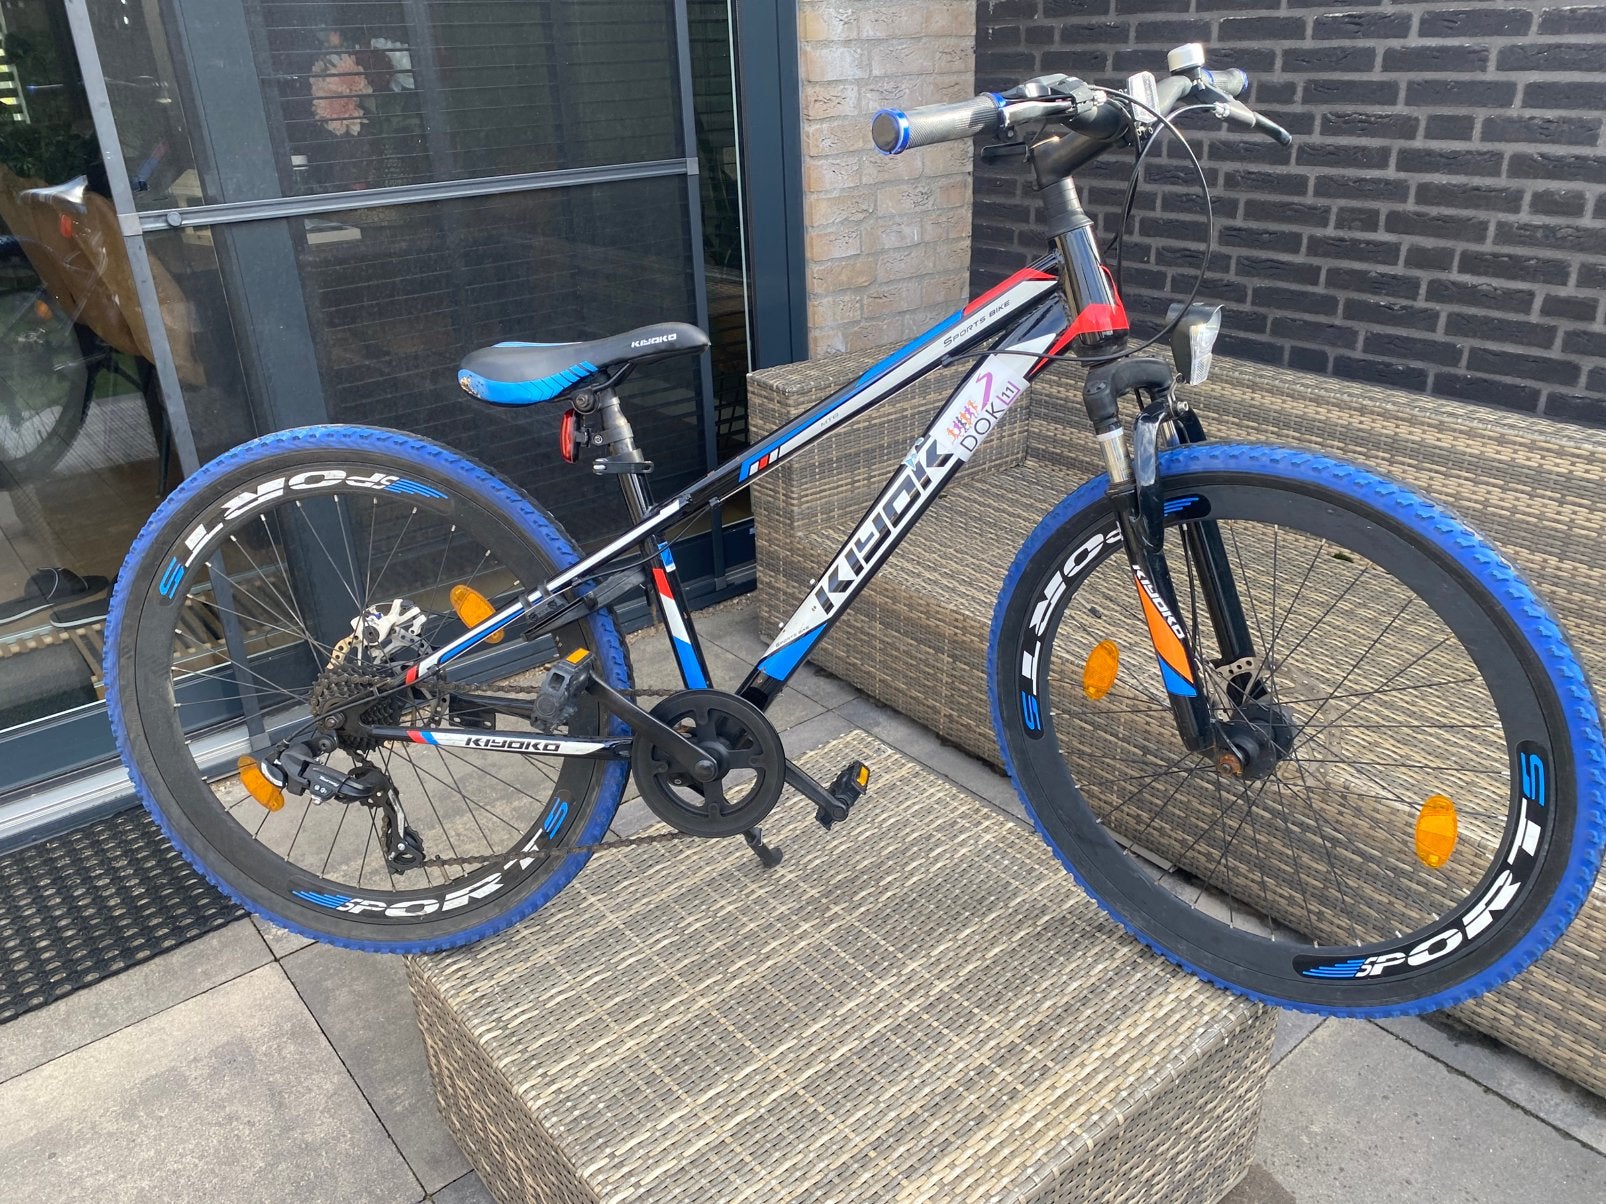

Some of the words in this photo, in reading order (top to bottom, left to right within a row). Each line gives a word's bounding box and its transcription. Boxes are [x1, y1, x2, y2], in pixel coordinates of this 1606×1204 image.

[943, 315, 986, 348] SPORTS
[988, 299, 1010, 318] BIKE
[960, 401, 1006, 452] DOK
[1001, 386, 1015, 399] 11
[814, 438, 954, 616] KIYOK
[1021, 521, 1124, 732] PORTS
[1132, 564, 1186, 640] KIYOKO
[464, 736, 563, 753] KIYOKO
